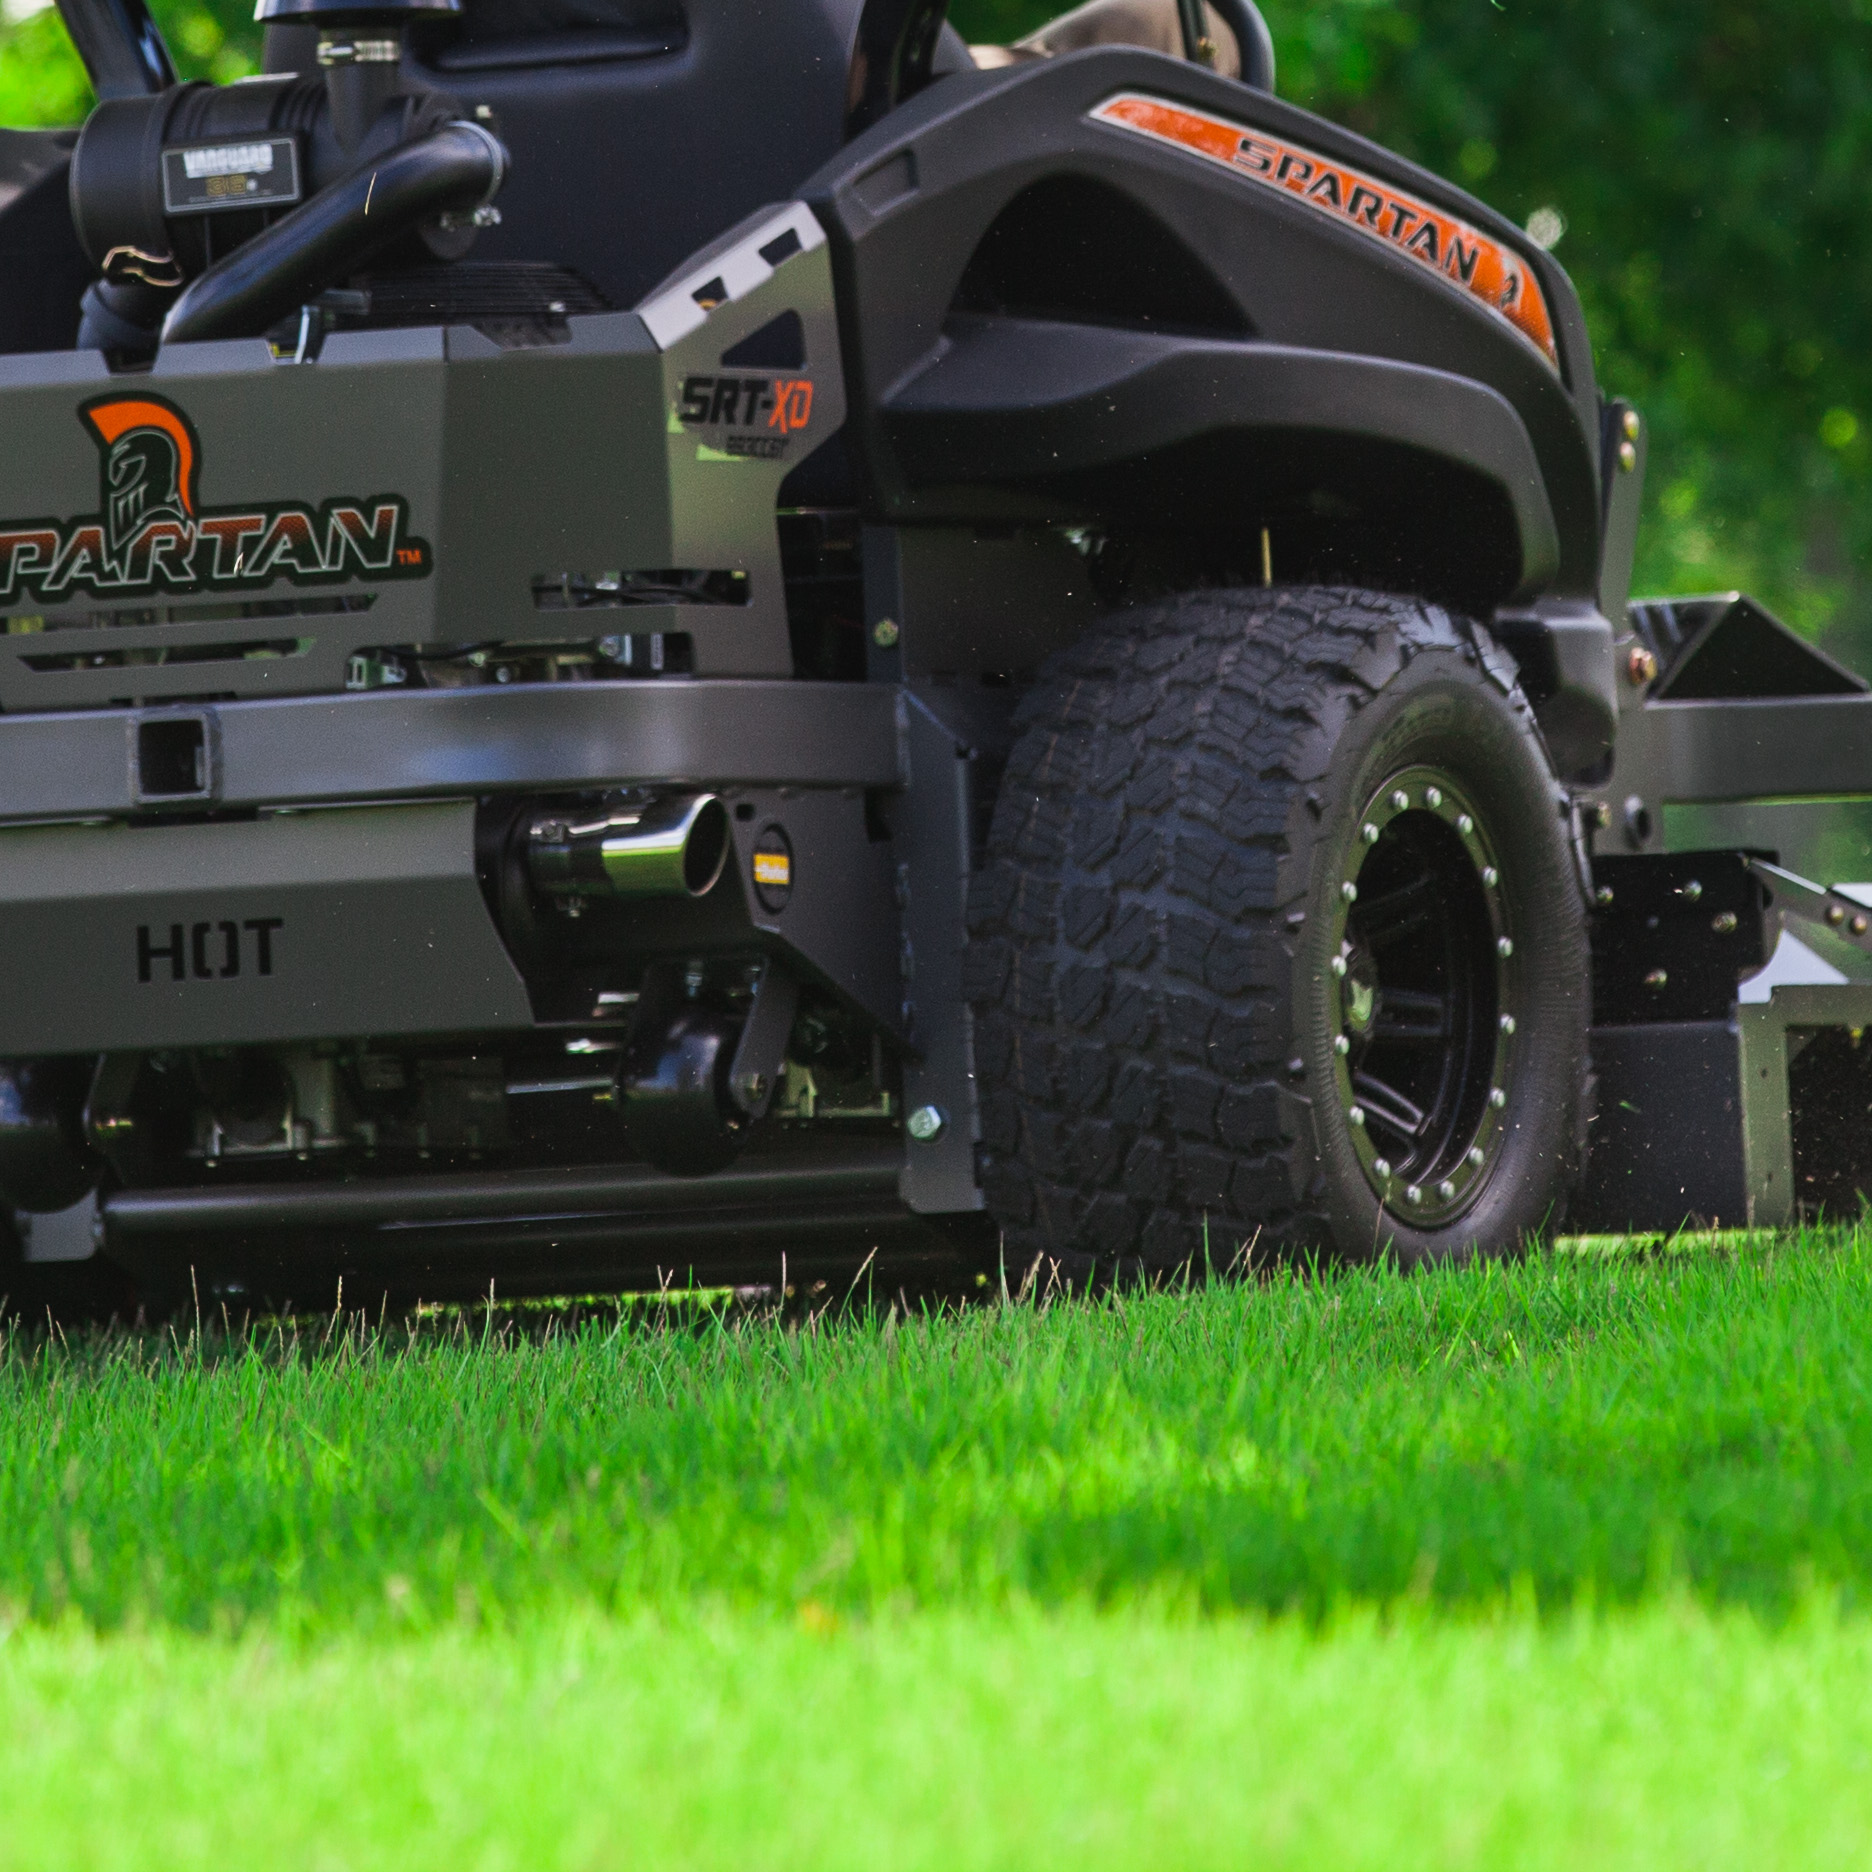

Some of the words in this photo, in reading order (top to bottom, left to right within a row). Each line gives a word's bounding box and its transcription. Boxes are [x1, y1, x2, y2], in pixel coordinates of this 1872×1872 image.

[1233, 136, 1481, 286] SPARTAN
[678, 376, 814, 434] SRT-XD
[137, 918, 283, 983] HOT
